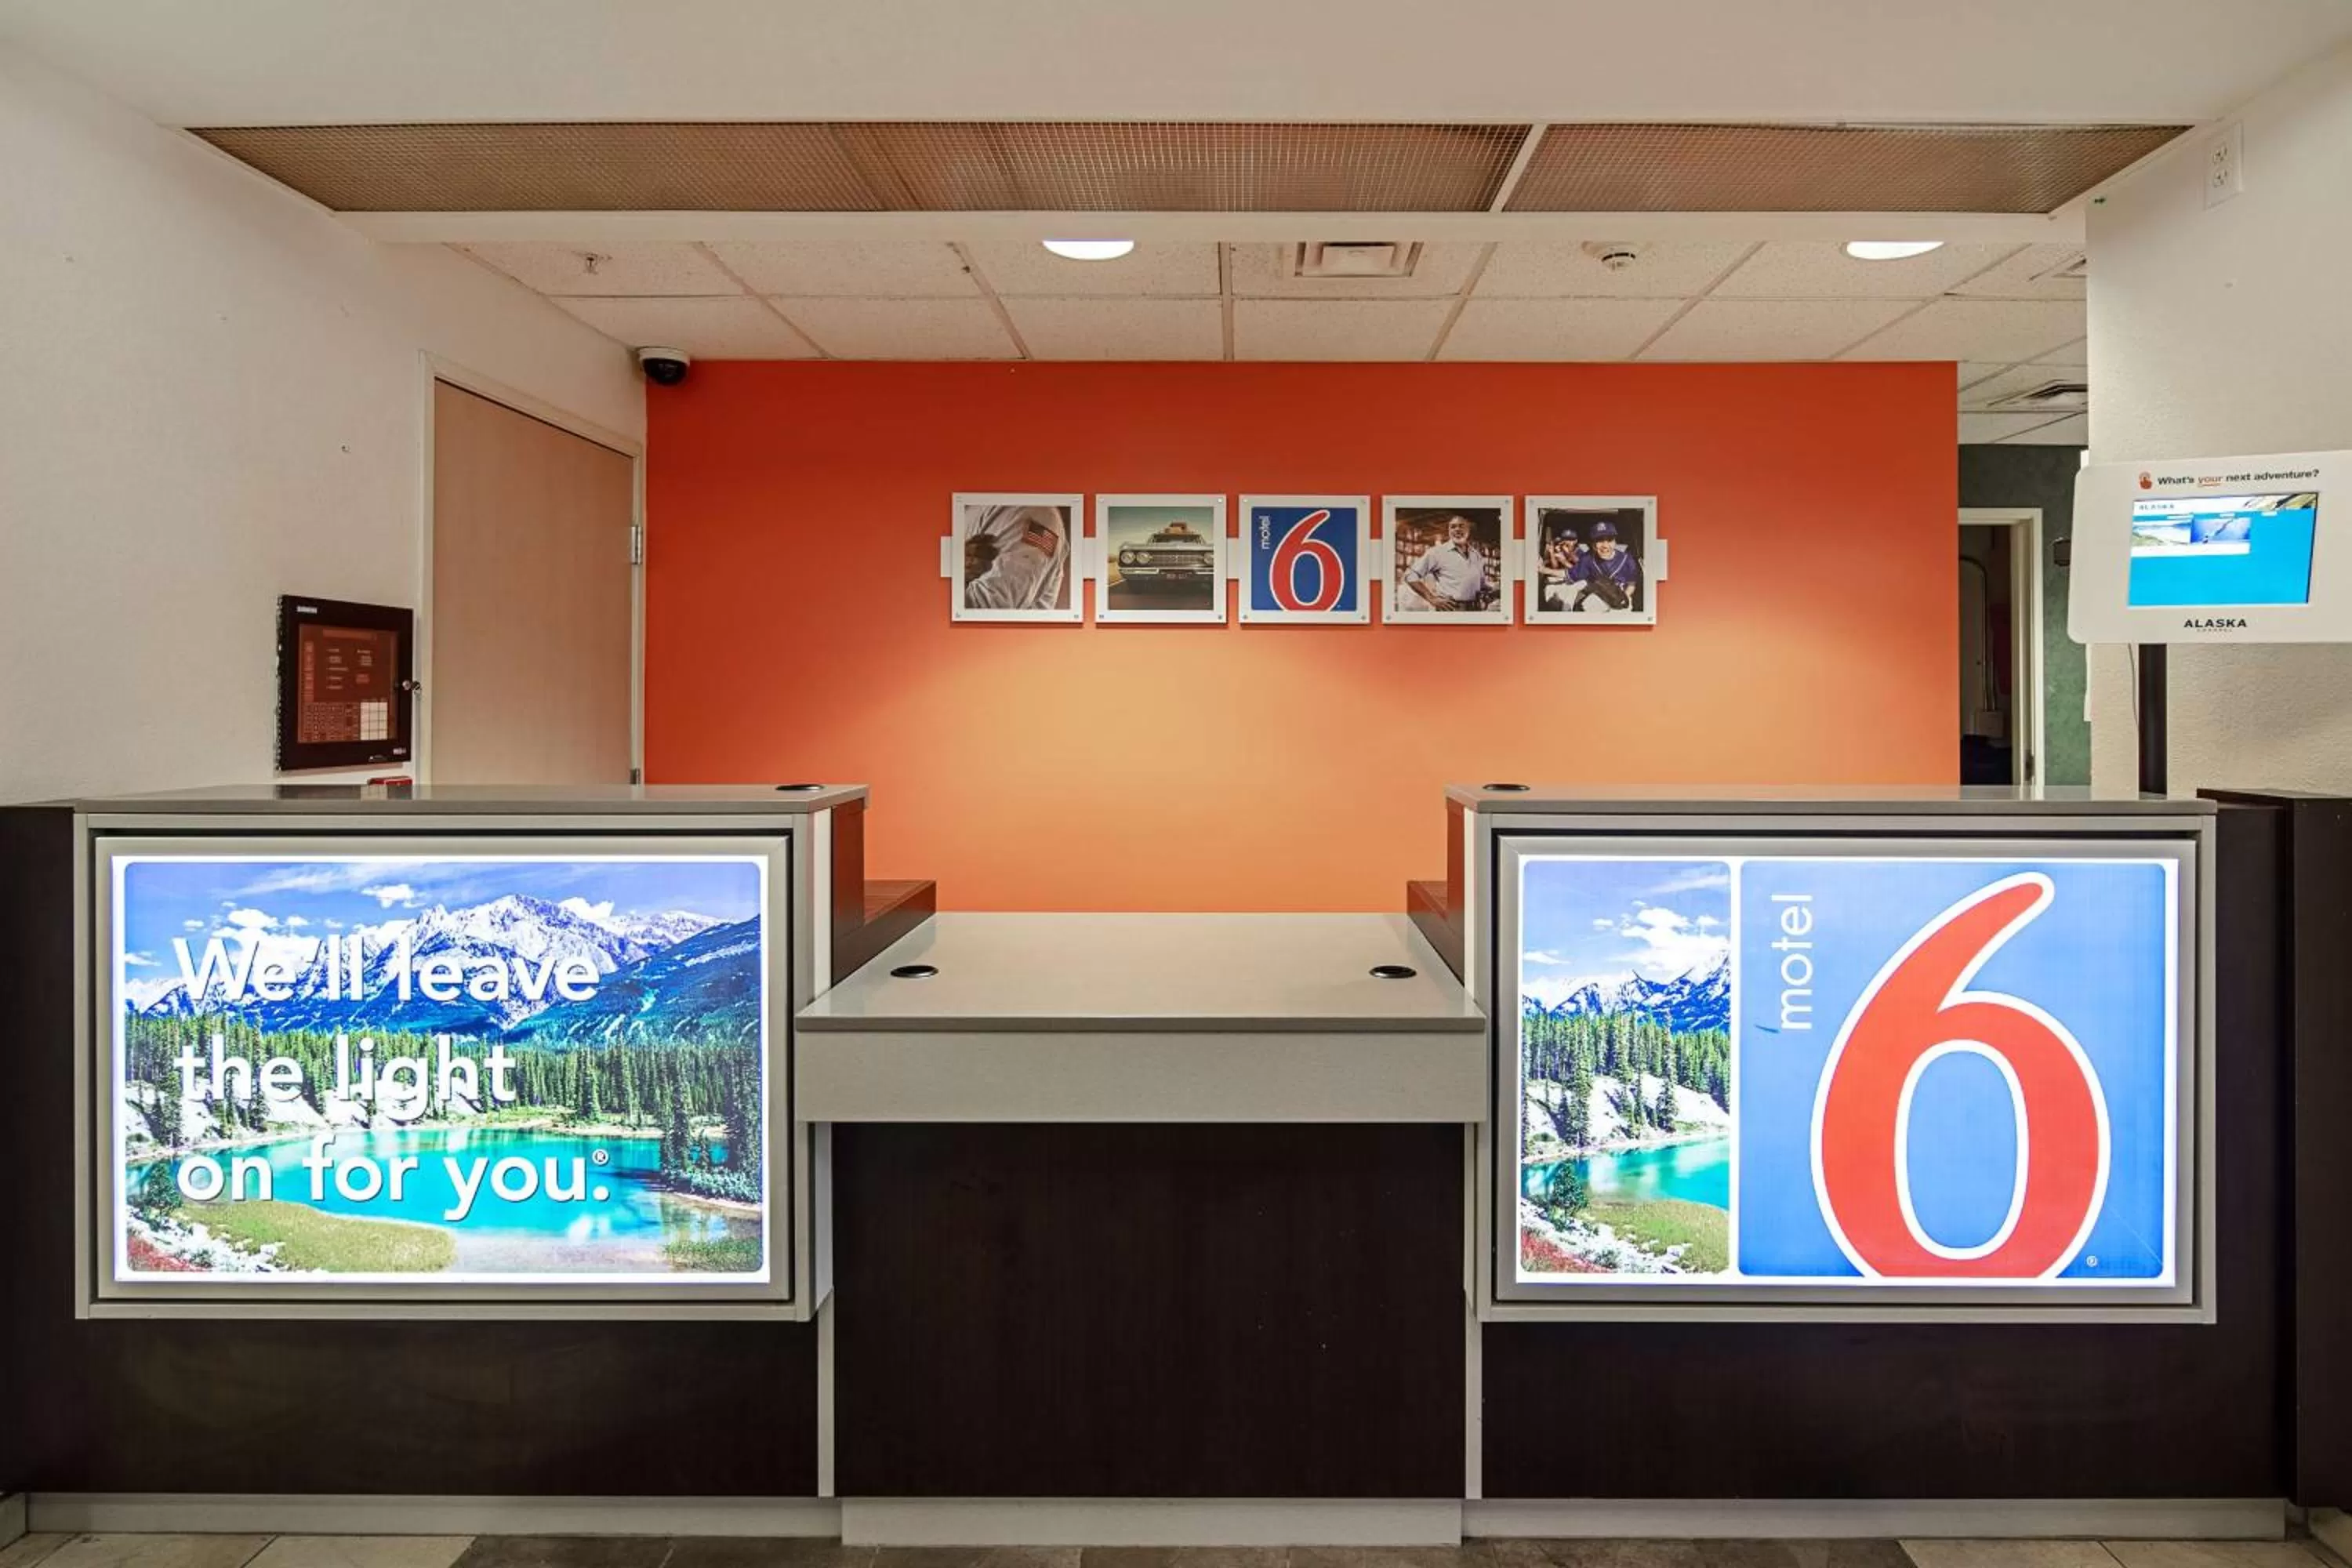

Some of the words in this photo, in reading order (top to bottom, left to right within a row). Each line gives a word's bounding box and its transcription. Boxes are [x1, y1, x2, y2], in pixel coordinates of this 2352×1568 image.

[2158, 475, 2194, 485] What's
[2198, 475, 2223, 487] your
[2227, 472, 2251, 481] next
[2254, 469, 2320, 481] adventure?
[1259, 515, 1270, 550] motel
[1269, 510, 1345, 612] 6
[2183, 618, 2247, 628] ALASKA
[172, 934, 365, 1001] We'll
[398, 936, 600, 1001] leave
[1772, 895, 1813, 1029] motel
[173, 1033, 304, 1102] the
[336, 1033, 517, 1120] light
[1810, 872, 2111, 1279] 6
[176, 1153, 273, 1202] on
[303, 1133, 419, 1201] for
